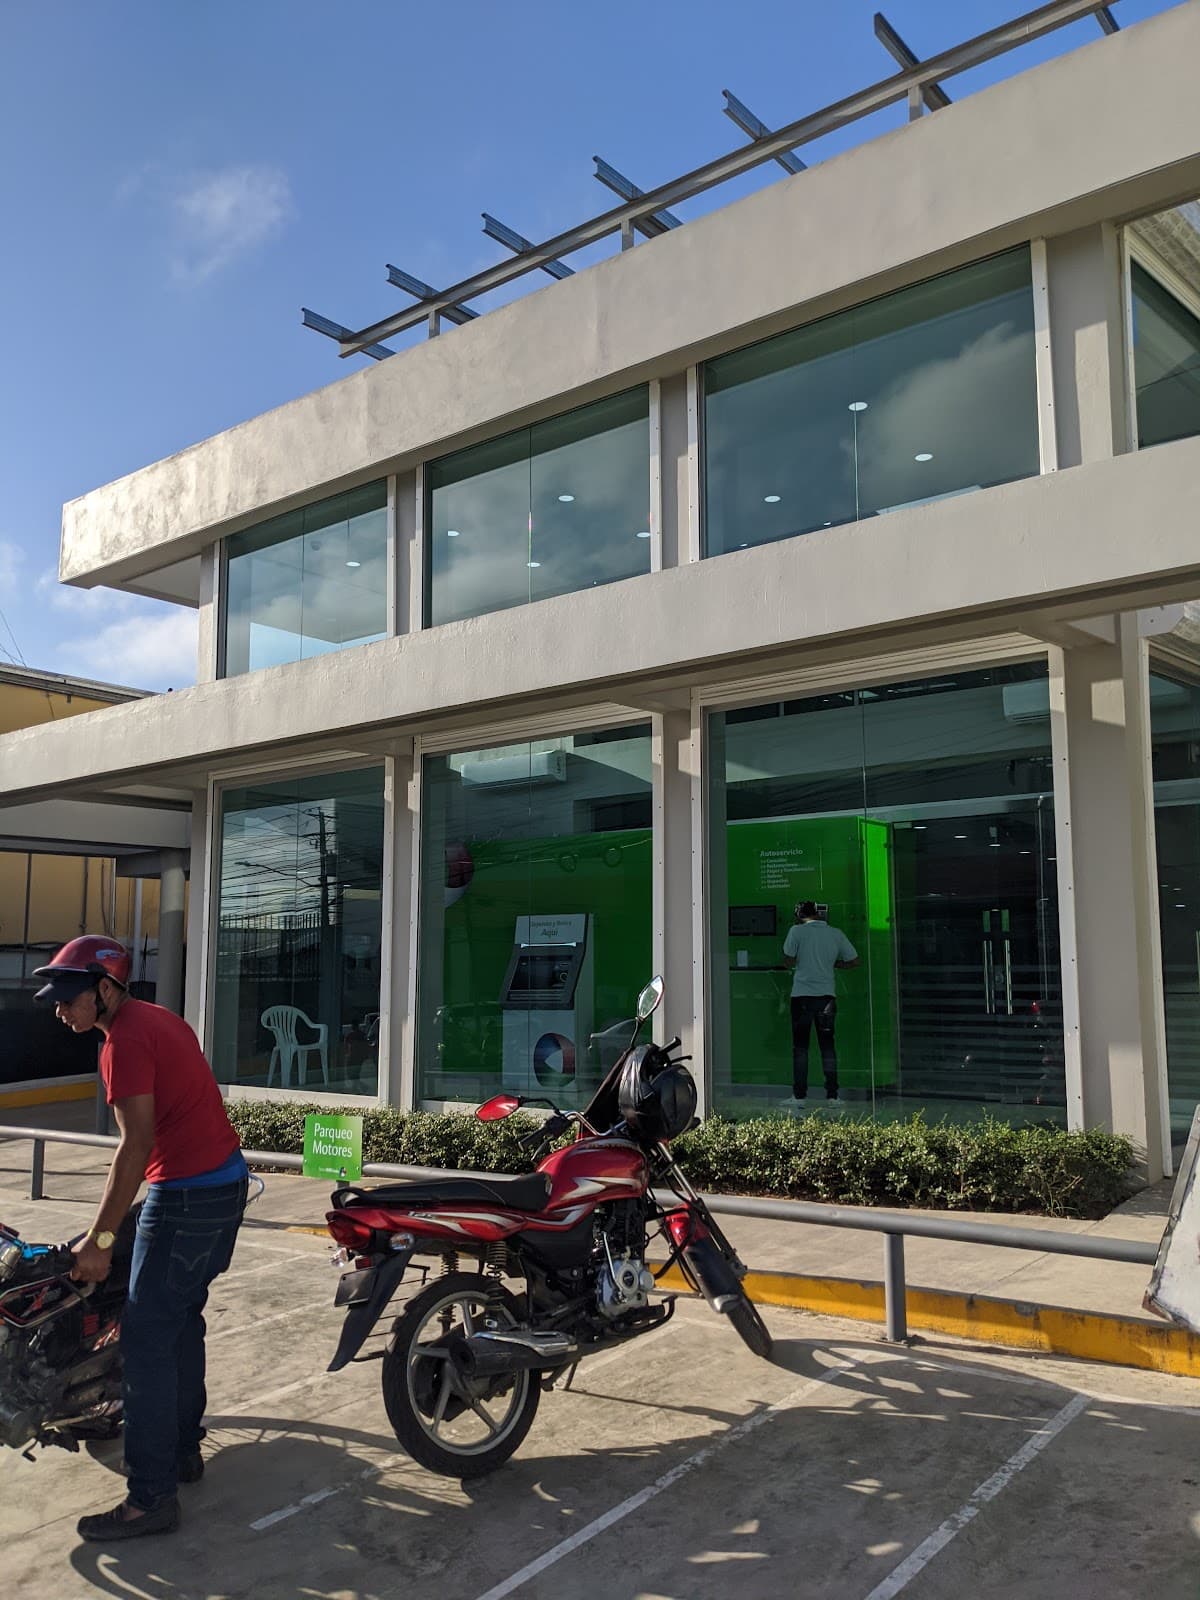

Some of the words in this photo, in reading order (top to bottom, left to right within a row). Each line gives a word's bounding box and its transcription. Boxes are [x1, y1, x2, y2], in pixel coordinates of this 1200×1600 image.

[760, 848, 804, 857] Autoservicio
[313, 1122, 353, 1143] Parqueo
[312, 1139, 353, 1158] Motores
